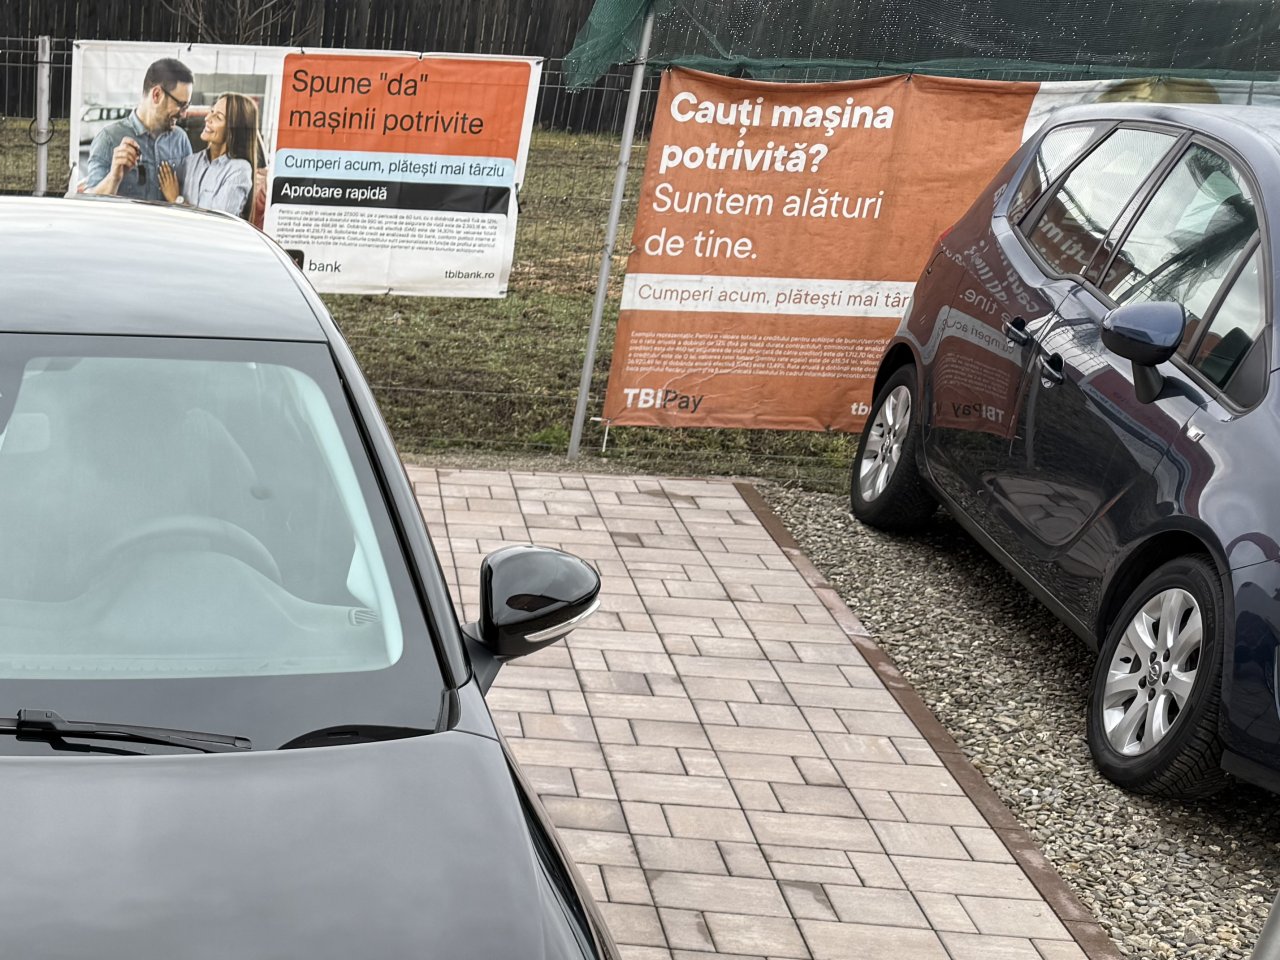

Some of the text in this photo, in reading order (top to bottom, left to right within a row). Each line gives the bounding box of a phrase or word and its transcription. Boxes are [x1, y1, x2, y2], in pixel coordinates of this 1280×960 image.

[292, 70, 428, 97] Spune "da"
[382, 111, 484, 135] potrivite
[670, 92, 764, 138] Cauți
[284, 155, 341, 172] Cumperi
[344, 160, 384, 174] acum,
[440, 162, 465, 175] mai
[469, 162, 505, 177] târziu
[658, 140, 828, 174] potrivită?
[280, 182, 388, 202] Aprobare rapidă
[652, 182, 884, 219] Suntem alături
[644, 228, 758, 259] de tine.
[308, 259, 342, 272] bank
[638, 284, 714, 304] Cumperi
[846, 292, 880, 307] mai
[623, 388, 704, 414] TBIPay
